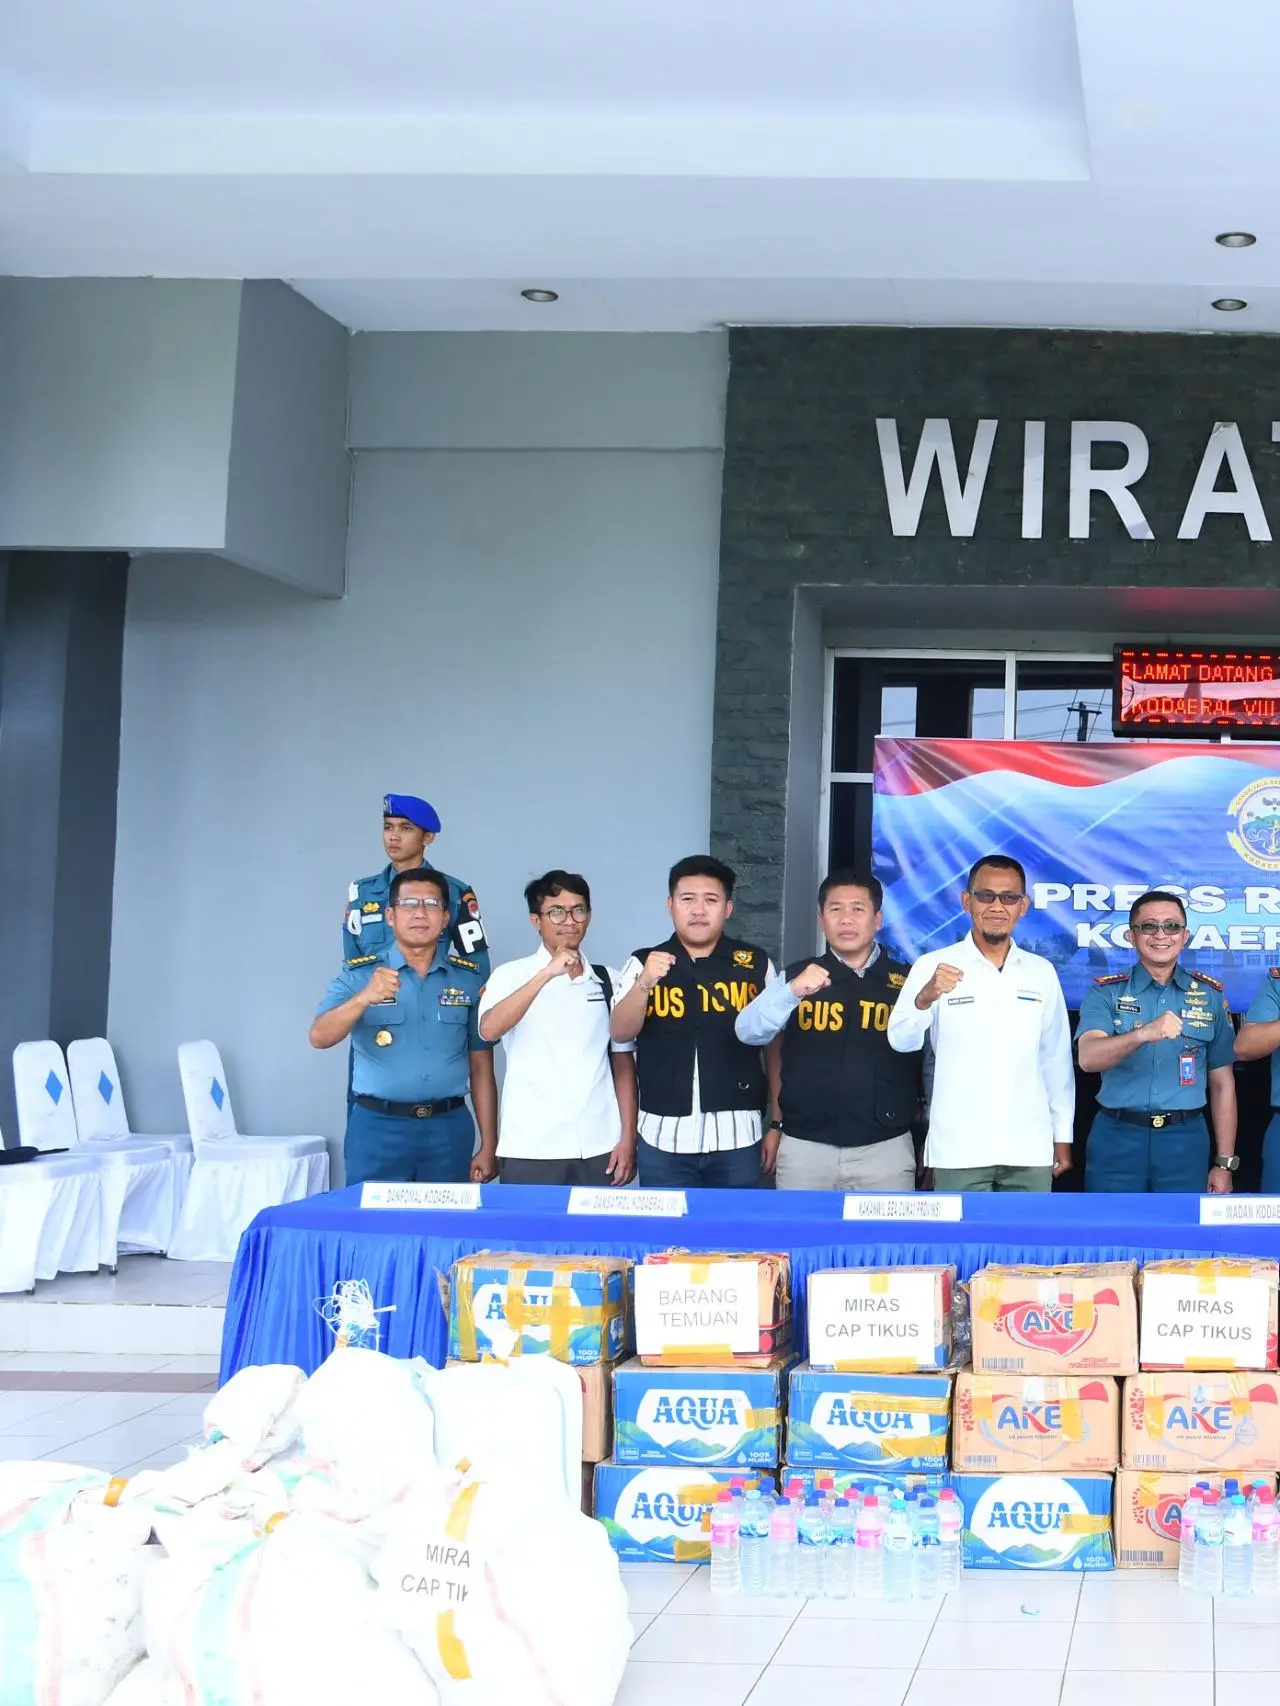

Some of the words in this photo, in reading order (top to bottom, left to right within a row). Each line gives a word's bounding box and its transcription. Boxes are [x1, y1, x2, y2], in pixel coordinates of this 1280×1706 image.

[1200, 665, 1273, 682] DATANG
[1132, 698, 1236, 716] KODAERAL
[1243, 700, 1275, 717] VIII
[798, 1000, 844, 1031] CUS
[859, 999, 891, 1032] TO
[1225, 1204, 1253, 1219] WADAN
[659, 1288, 738, 1305] BARANG
[844, 1298, 900, 1312] MIRAS
[1178, 1299, 1234, 1315] MIRAS
[659, 1310, 738, 1327] TEMUAN
[825, 1323, 861, 1338] CAP
[867, 1323, 919, 1338] TIKUS
[1157, 1323, 1194, 1338] CAP
[1200, 1324, 1252, 1341] TIKUS
[653, 1396, 739, 1430] AQUA
[827, 1398, 914, 1434] AQUA
[997, 1405, 1062, 1434] AKE
[1166, 1405, 1233, 1434] AKE
[987, 1501, 1072, 1535] AQUA
[426, 1543, 470, 1568] MIRA
[401, 1573, 440, 1596] CAP
